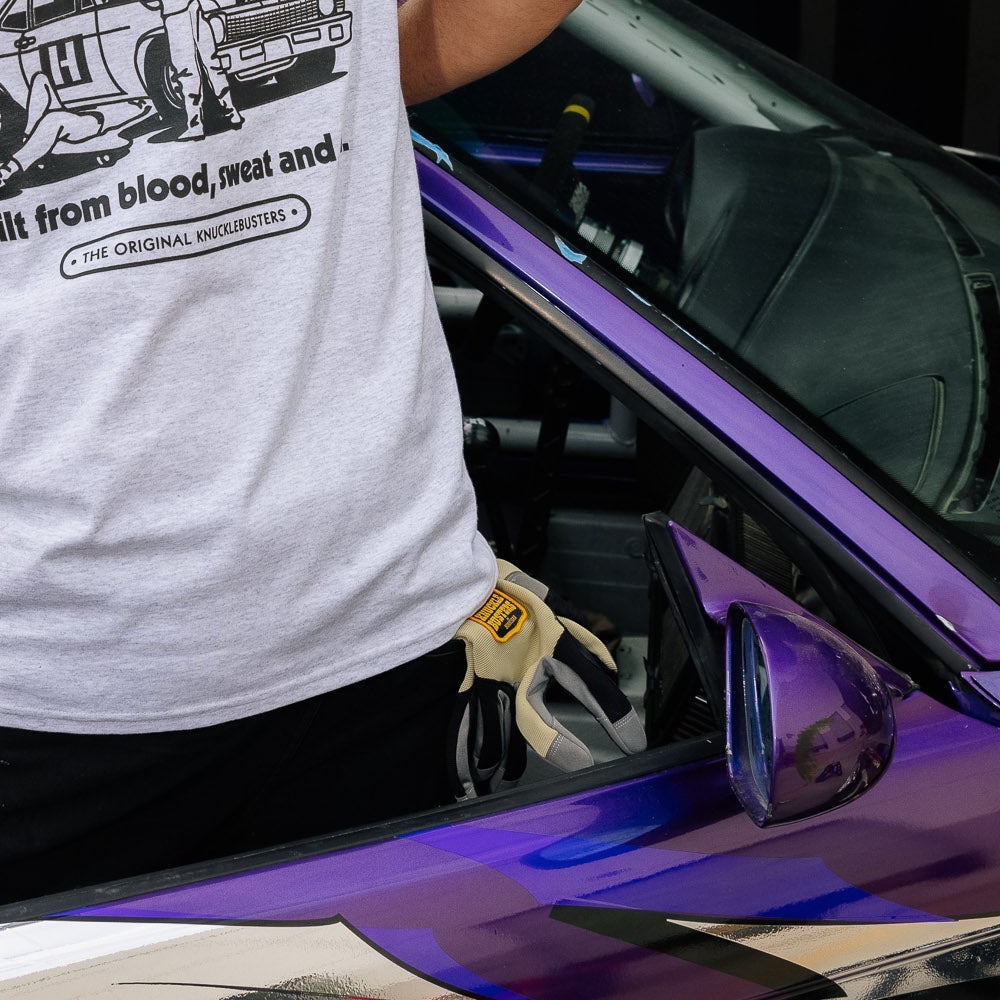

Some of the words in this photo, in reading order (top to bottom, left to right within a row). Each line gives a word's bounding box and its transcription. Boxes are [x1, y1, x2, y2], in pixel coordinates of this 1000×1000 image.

[34, 191, 112, 235] from
[117, 164, 217, 210] blood,
[219, 150, 273, 191] sweat
[82, 246, 109, 264] THE
[113, 232, 193, 257] ORIGINAL
[196, 208, 287, 244] KNUCKLEBUSTERS
